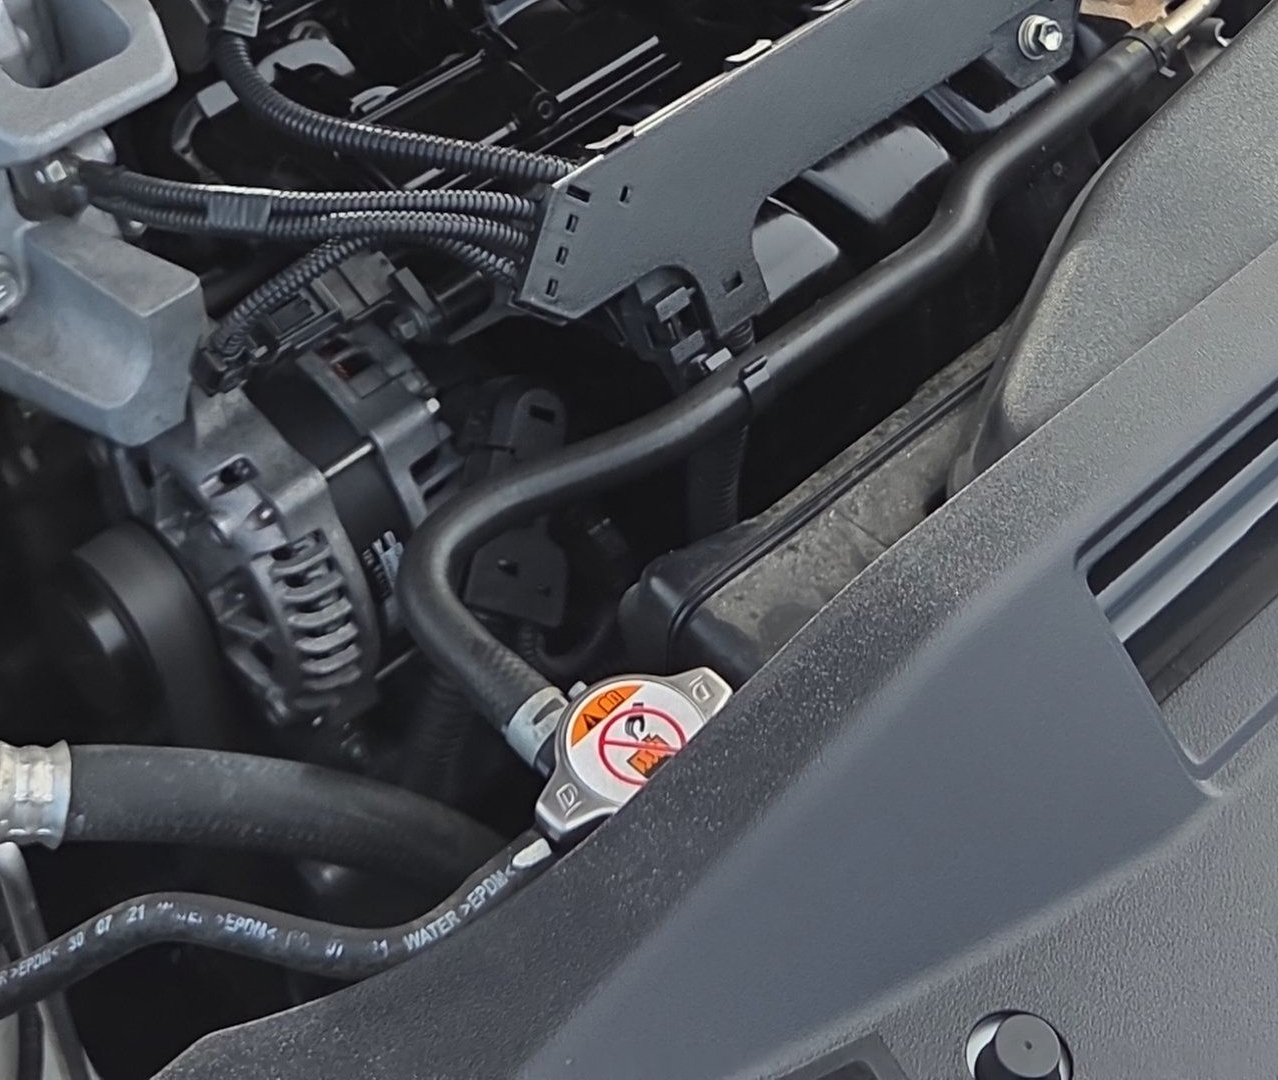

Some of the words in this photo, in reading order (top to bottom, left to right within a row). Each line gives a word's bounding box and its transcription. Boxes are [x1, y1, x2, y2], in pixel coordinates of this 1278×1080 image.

[66, 930, 85, 953] 30
[94, 913, 114, 935] 07
[125, 902, 146, 924] 21
[403, 909, 462, 952] WATER
